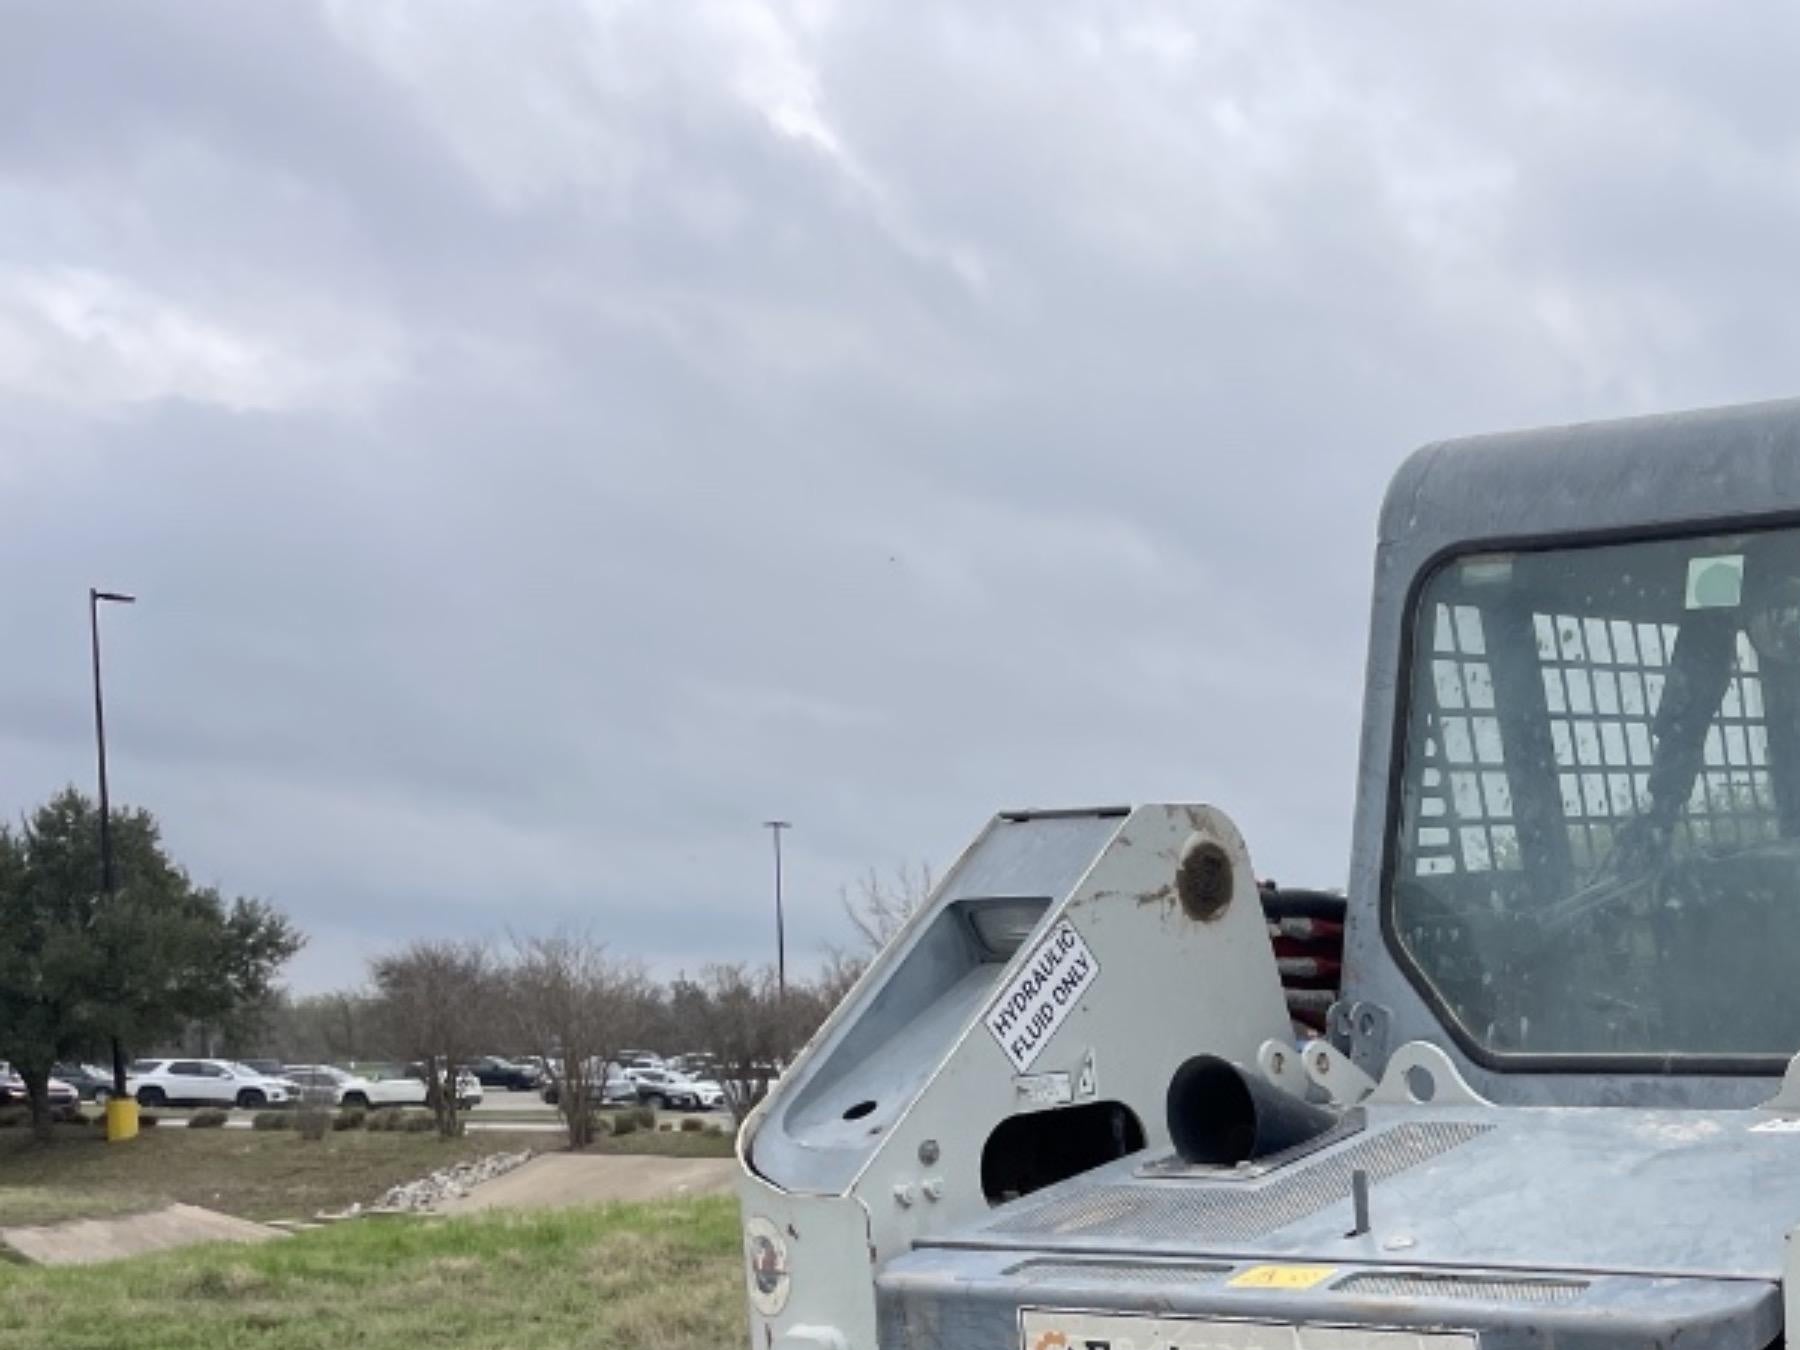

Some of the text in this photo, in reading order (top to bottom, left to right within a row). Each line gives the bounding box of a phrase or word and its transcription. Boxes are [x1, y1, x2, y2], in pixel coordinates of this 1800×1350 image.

[992, 927, 1076, 1039] HYDRAULIC
[1010, 1002, 1055, 1062] FLUID
[1051, 951, 1090, 1006] ONLY
